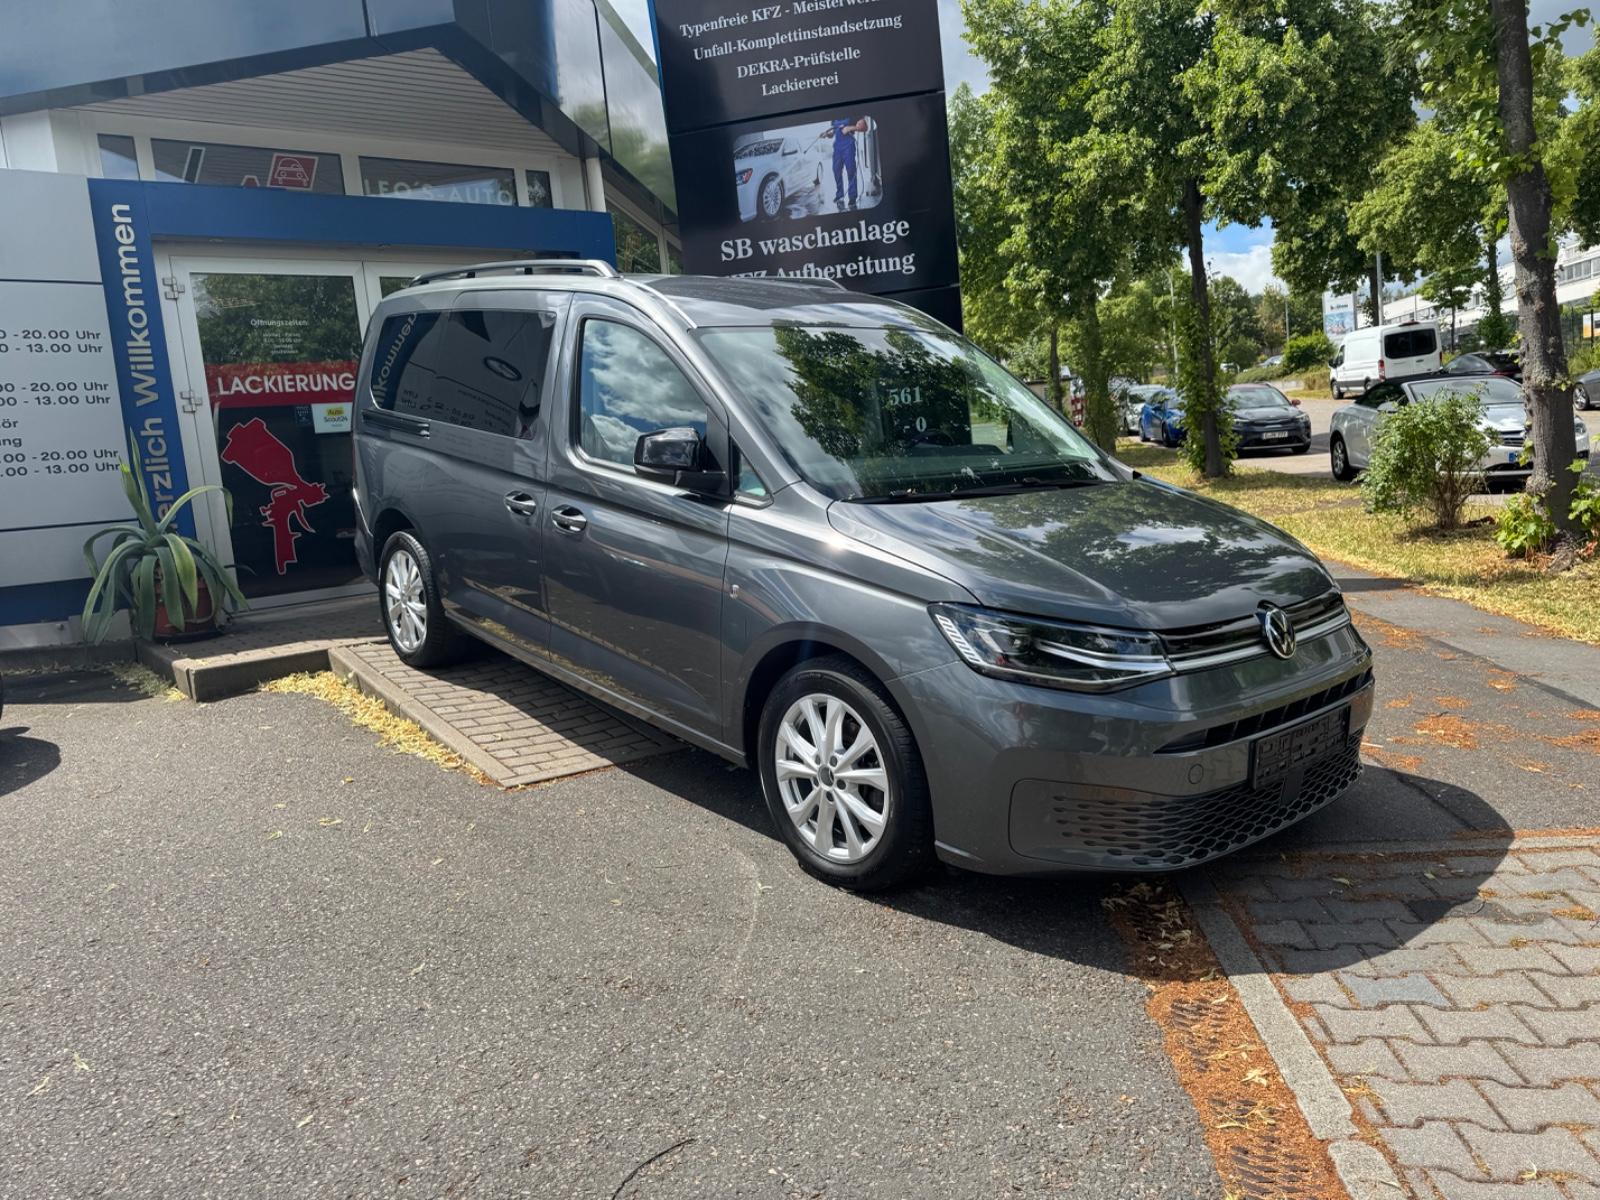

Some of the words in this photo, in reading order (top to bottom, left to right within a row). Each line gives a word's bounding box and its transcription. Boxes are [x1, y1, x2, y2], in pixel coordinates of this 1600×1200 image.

[679, 12, 749, 39] Typenfreie
[751, 5, 782, 22] KFZ
[693, 15, 903, 61] Unfall-Komplettinstandsetzung
[736, 46, 861, 79] DEKRA-Prüfstelle
[762, 72, 839, 96] Lackiererei
[720, 237, 754, 262] SB
[758, 219, 911, 256] waschanlage
[111, 203, 158, 407] Willkommen
[21, 329, 70, 340] 20.00
[75, 330, 101, 340] Uhr
[26, 343, 72, 353] 13.00
[77, 343, 103, 353] Uhr
[30, 381, 78, 392] 20.00
[83, 381, 109, 391] Uhr
[217, 372, 356, 396] LACKIERUNG
[34, 395, 79, 405] 13.00
[85, 395, 111, 404] Uhr
[40, 450, 88, 461] 20.00
[93, 449, 118, 459] Uhr
[45, 463, 90, 474] 13.00
[95, 462, 120, 472] Uhr
[140, 417, 178, 530] erzlich
